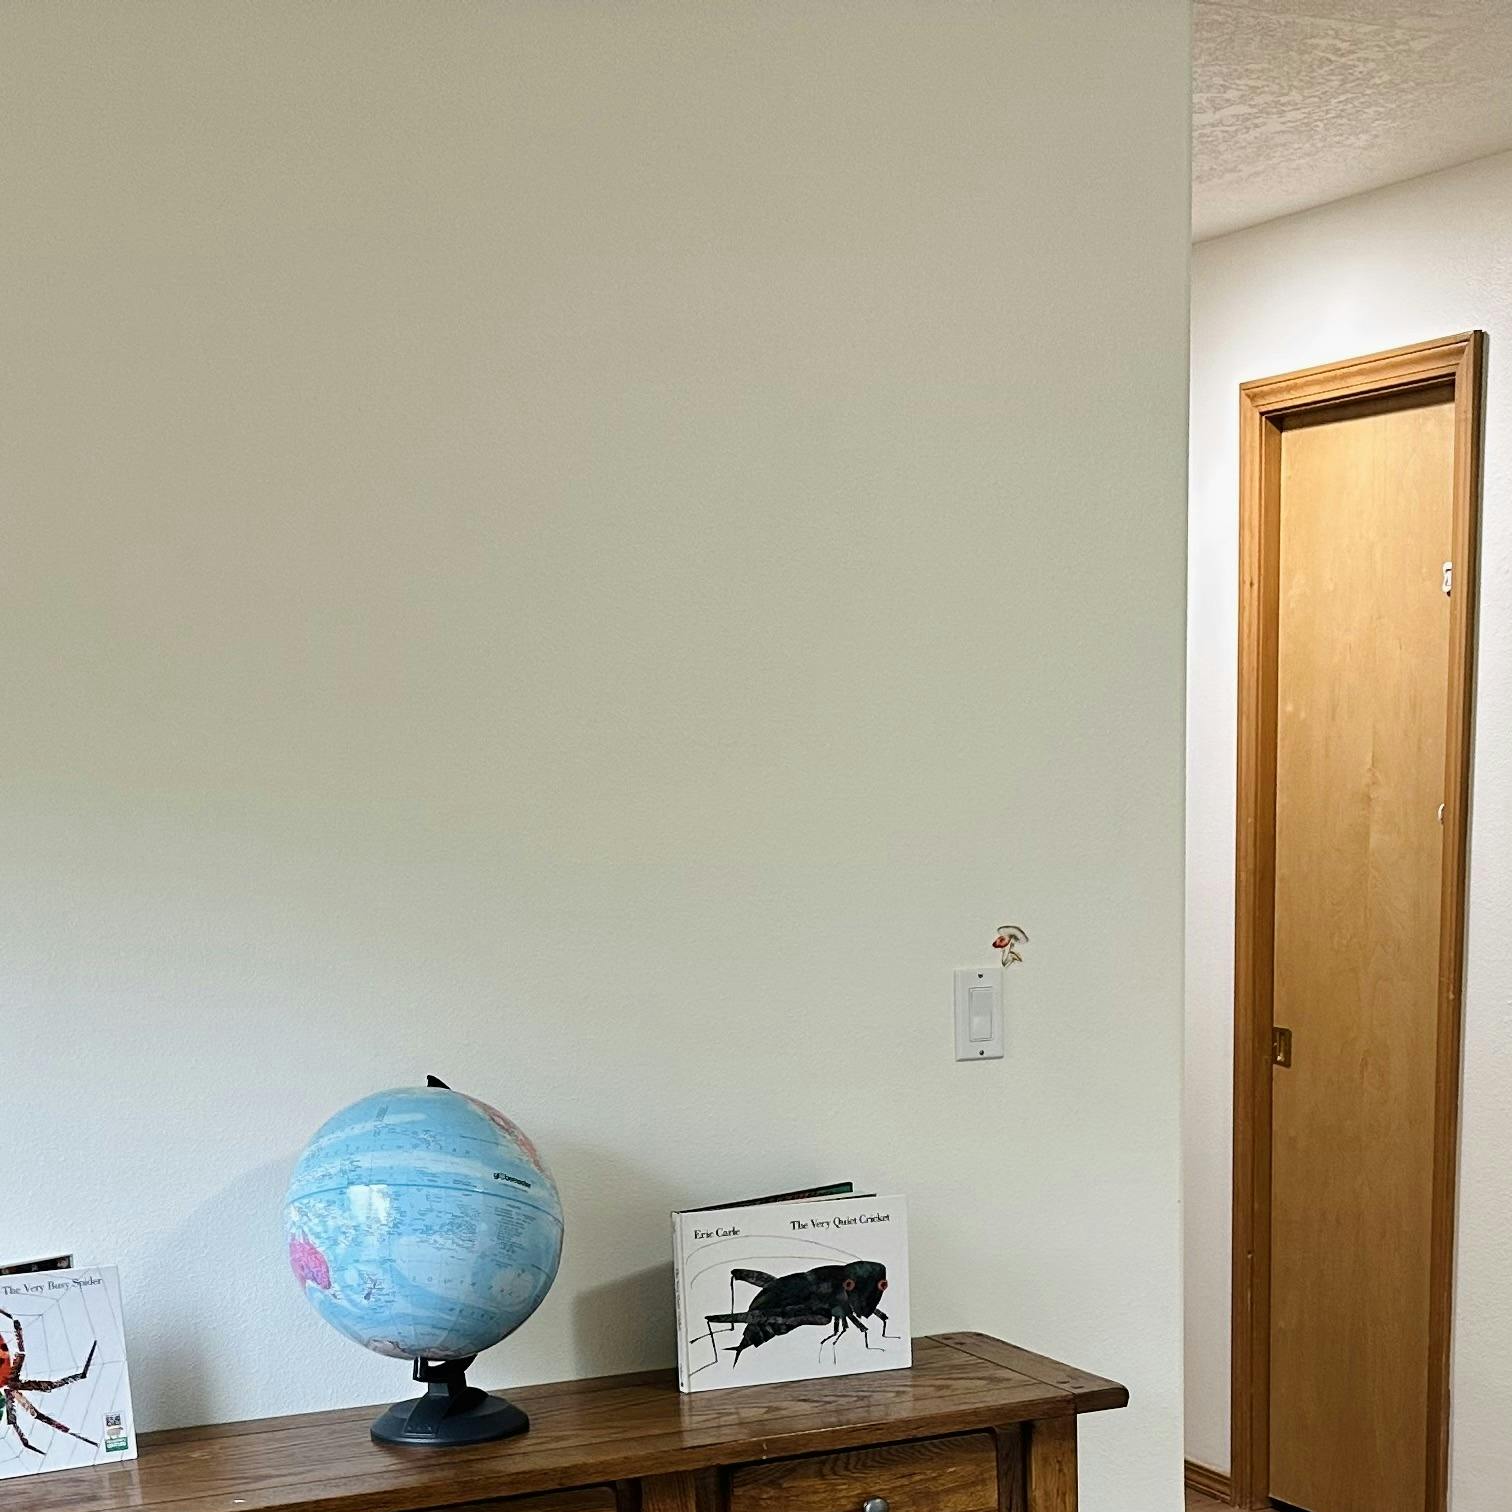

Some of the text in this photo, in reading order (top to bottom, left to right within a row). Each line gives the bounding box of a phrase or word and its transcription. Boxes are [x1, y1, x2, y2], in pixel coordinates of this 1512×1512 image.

[789, 1213, 890, 1231] The Very Quiet Cricket
[694, 1226, 740, 1240] Eric Carle
[2, 1286, 21, 1296] The
[23, 1283, 44, 1295] Very
